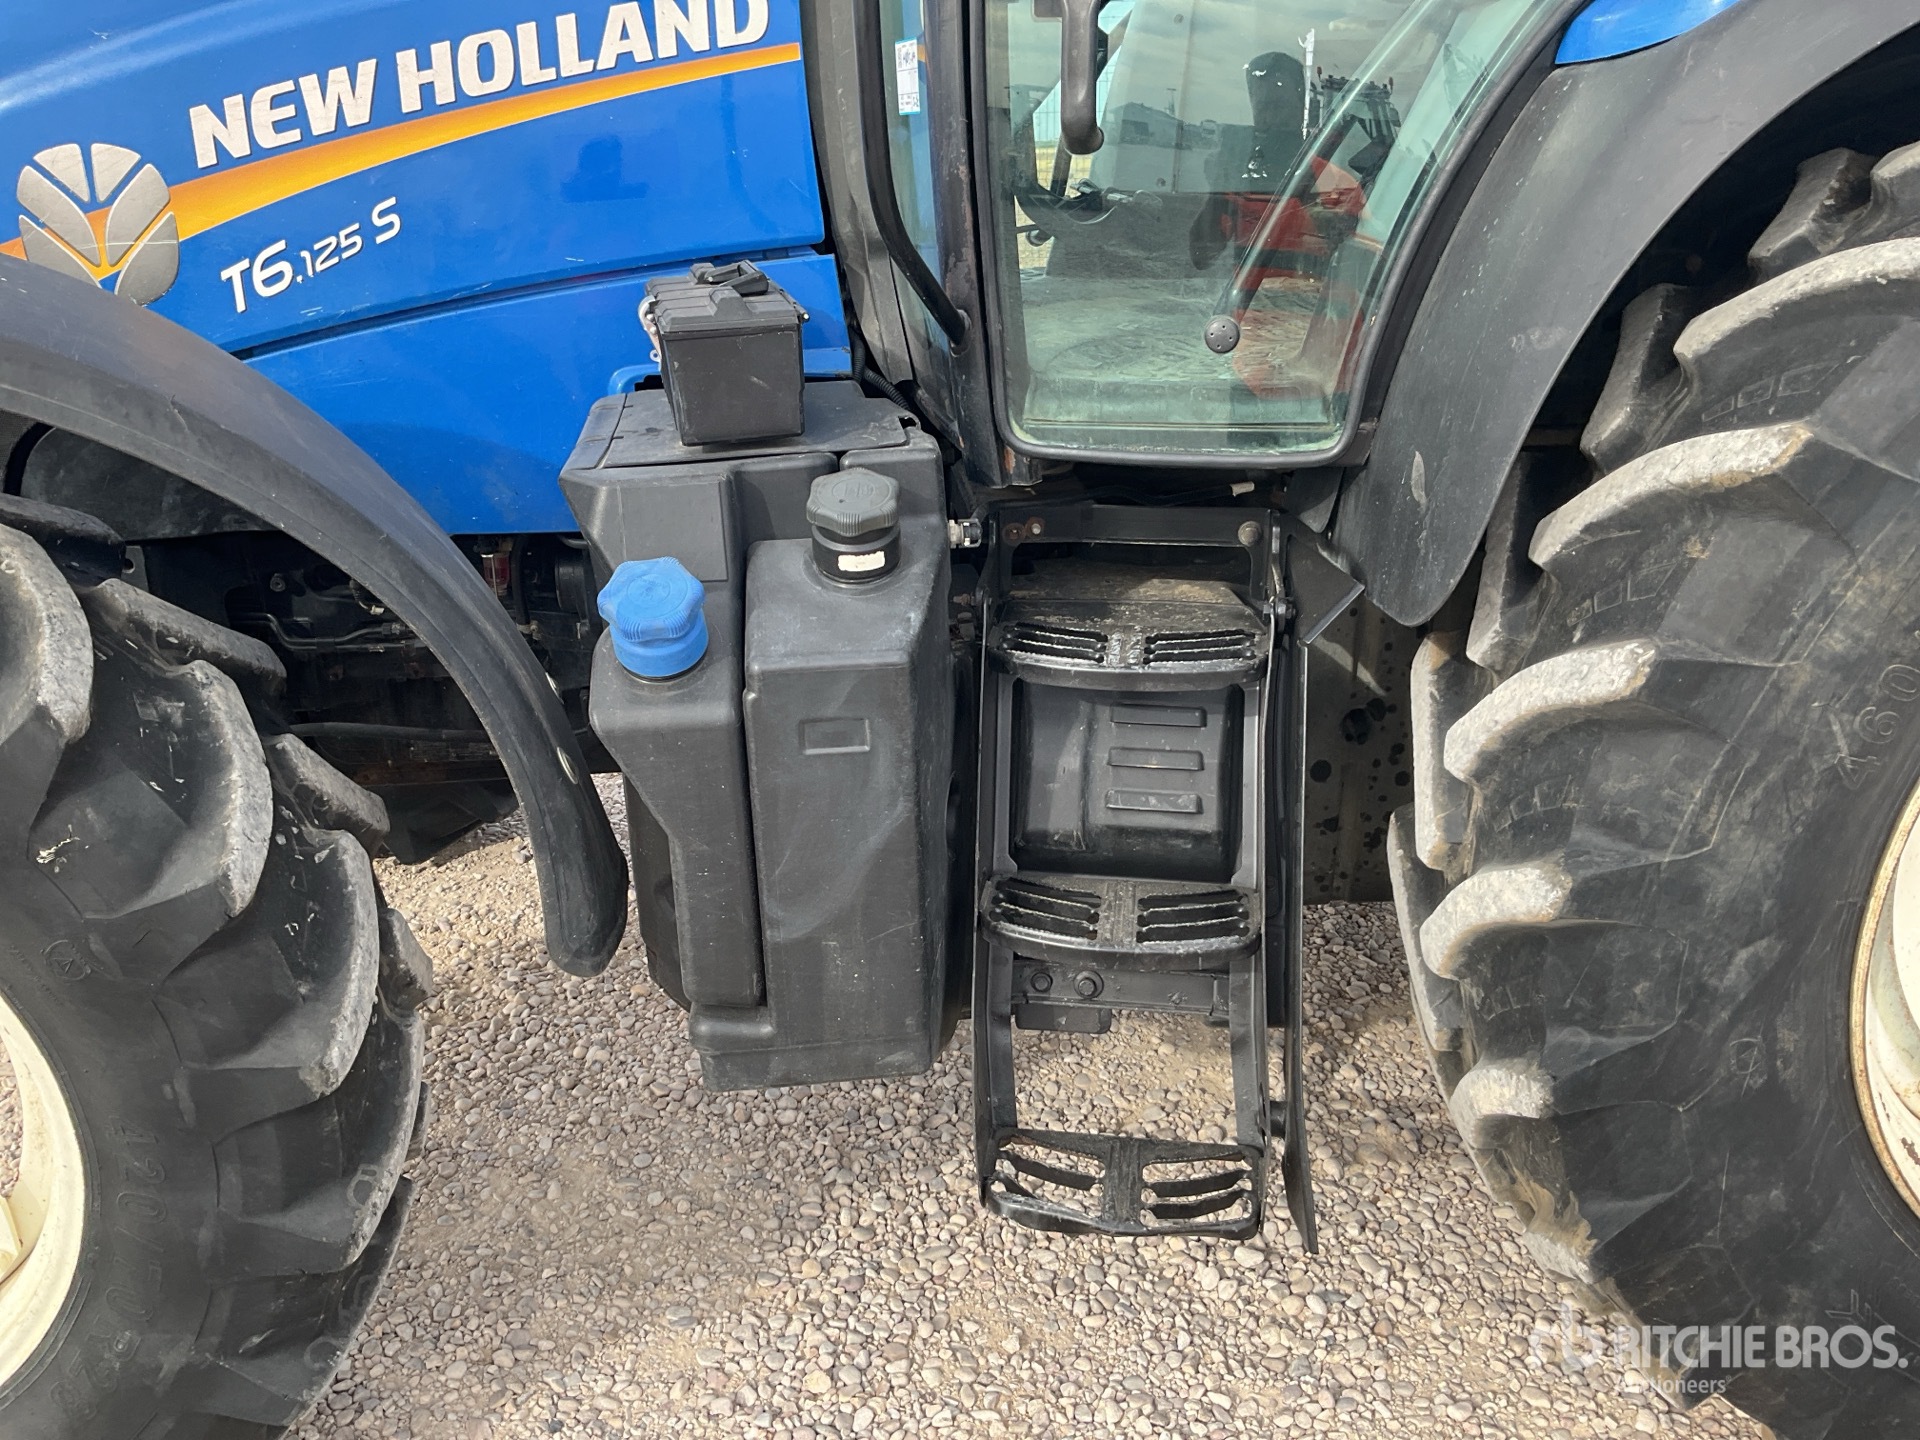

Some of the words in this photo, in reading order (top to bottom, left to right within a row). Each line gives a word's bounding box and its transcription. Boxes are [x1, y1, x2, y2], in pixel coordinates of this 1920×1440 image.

[189, 58, 377, 168] NEW
[396, 0, 769, 114] HOLLAND
[220, 222, 363, 313] T6.125
[371, 196, 401, 245] S
